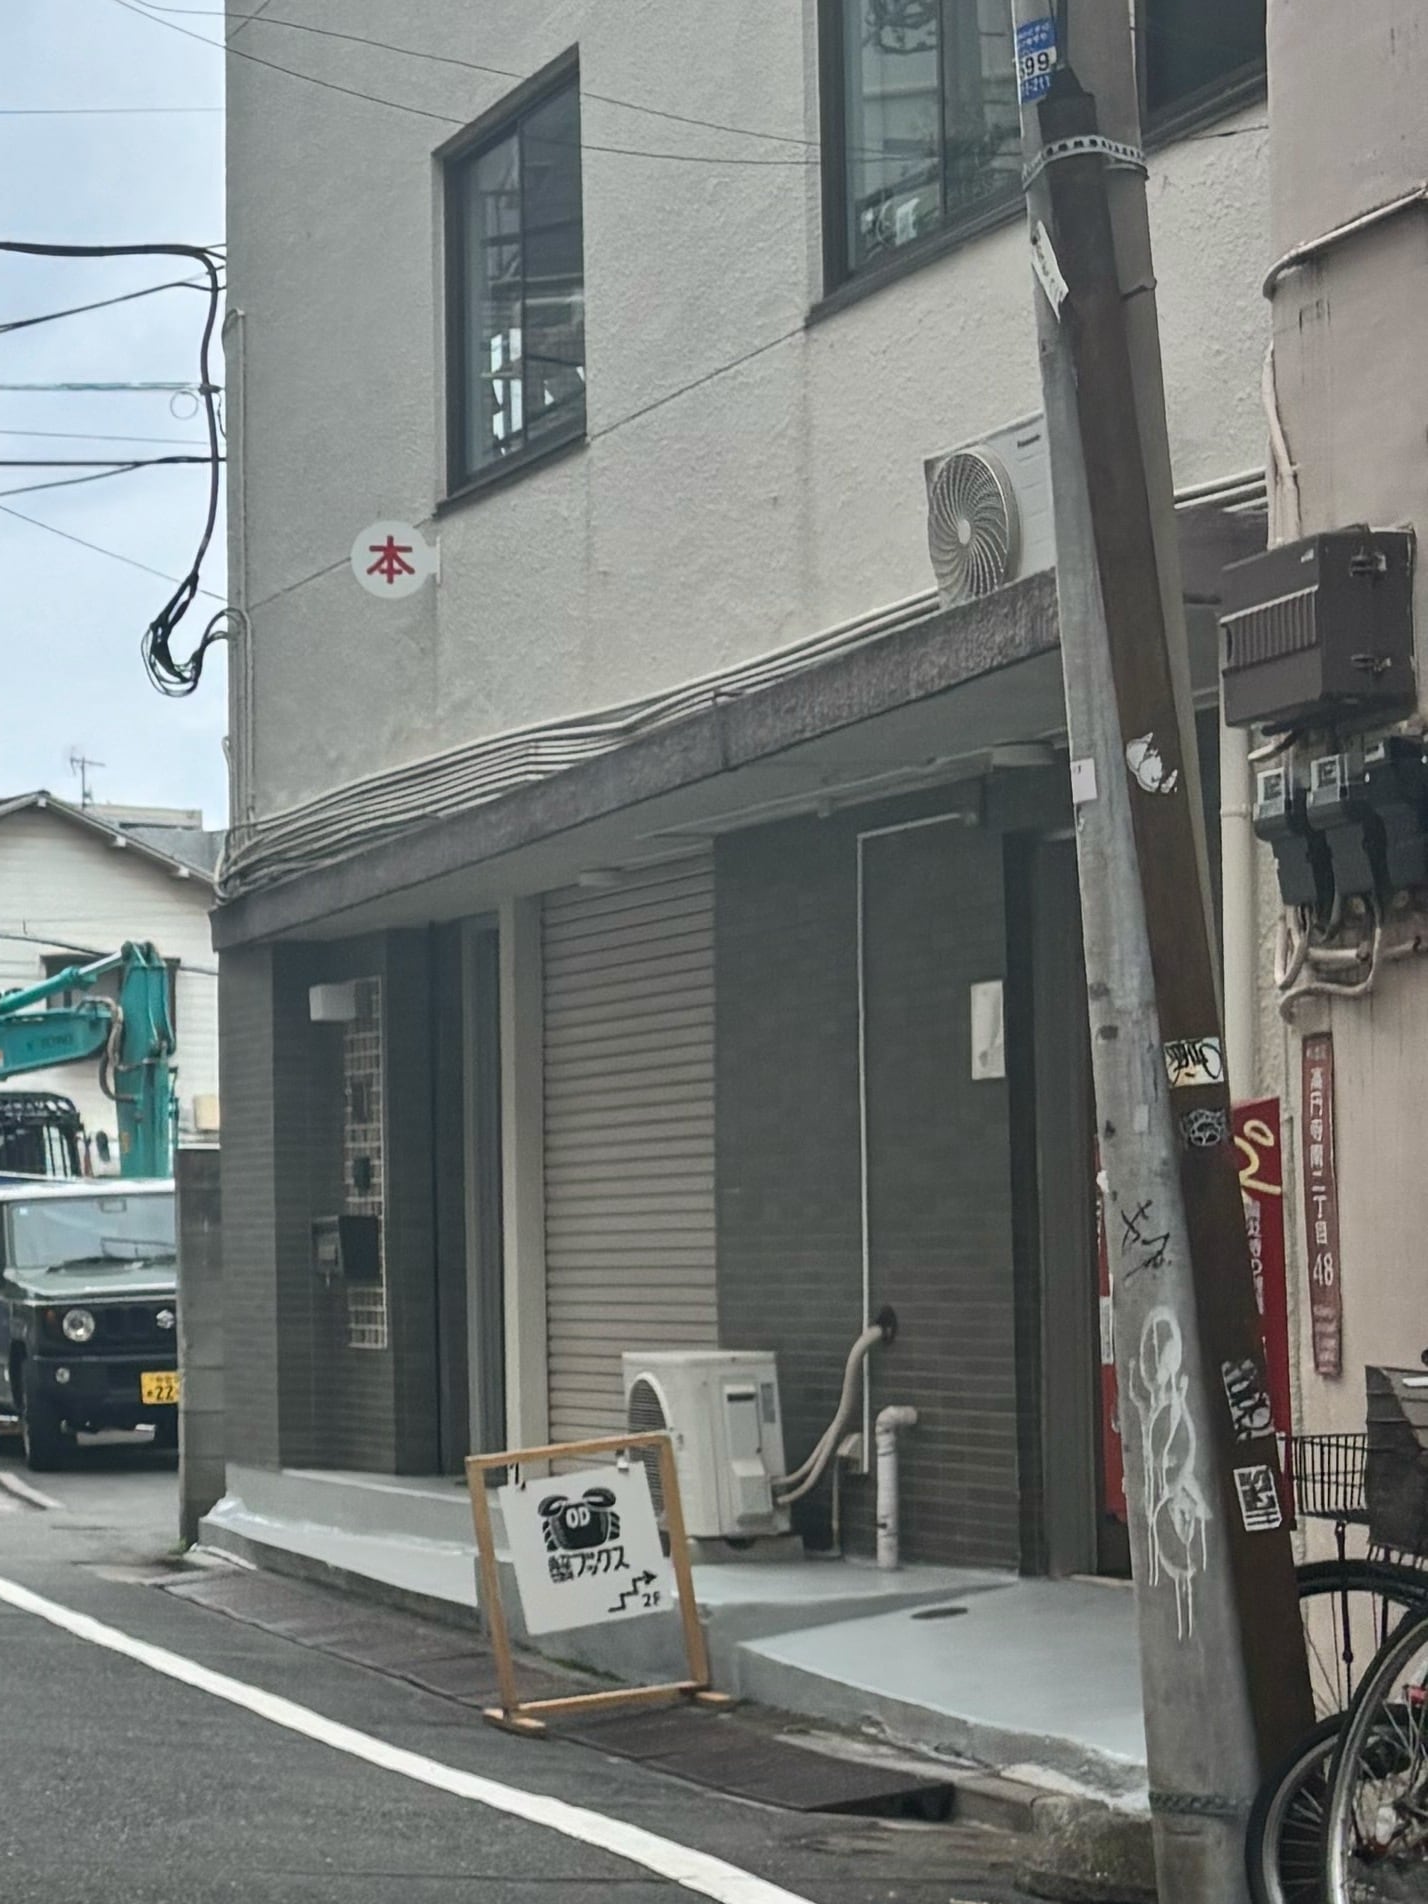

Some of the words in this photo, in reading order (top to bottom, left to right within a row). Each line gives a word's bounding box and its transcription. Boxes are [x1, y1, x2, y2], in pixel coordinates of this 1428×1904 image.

[366, 534, 415, 585] 本
[1312, 1251, 1334, 1287] 48
[641, 1591, 661, 1608] 2F
